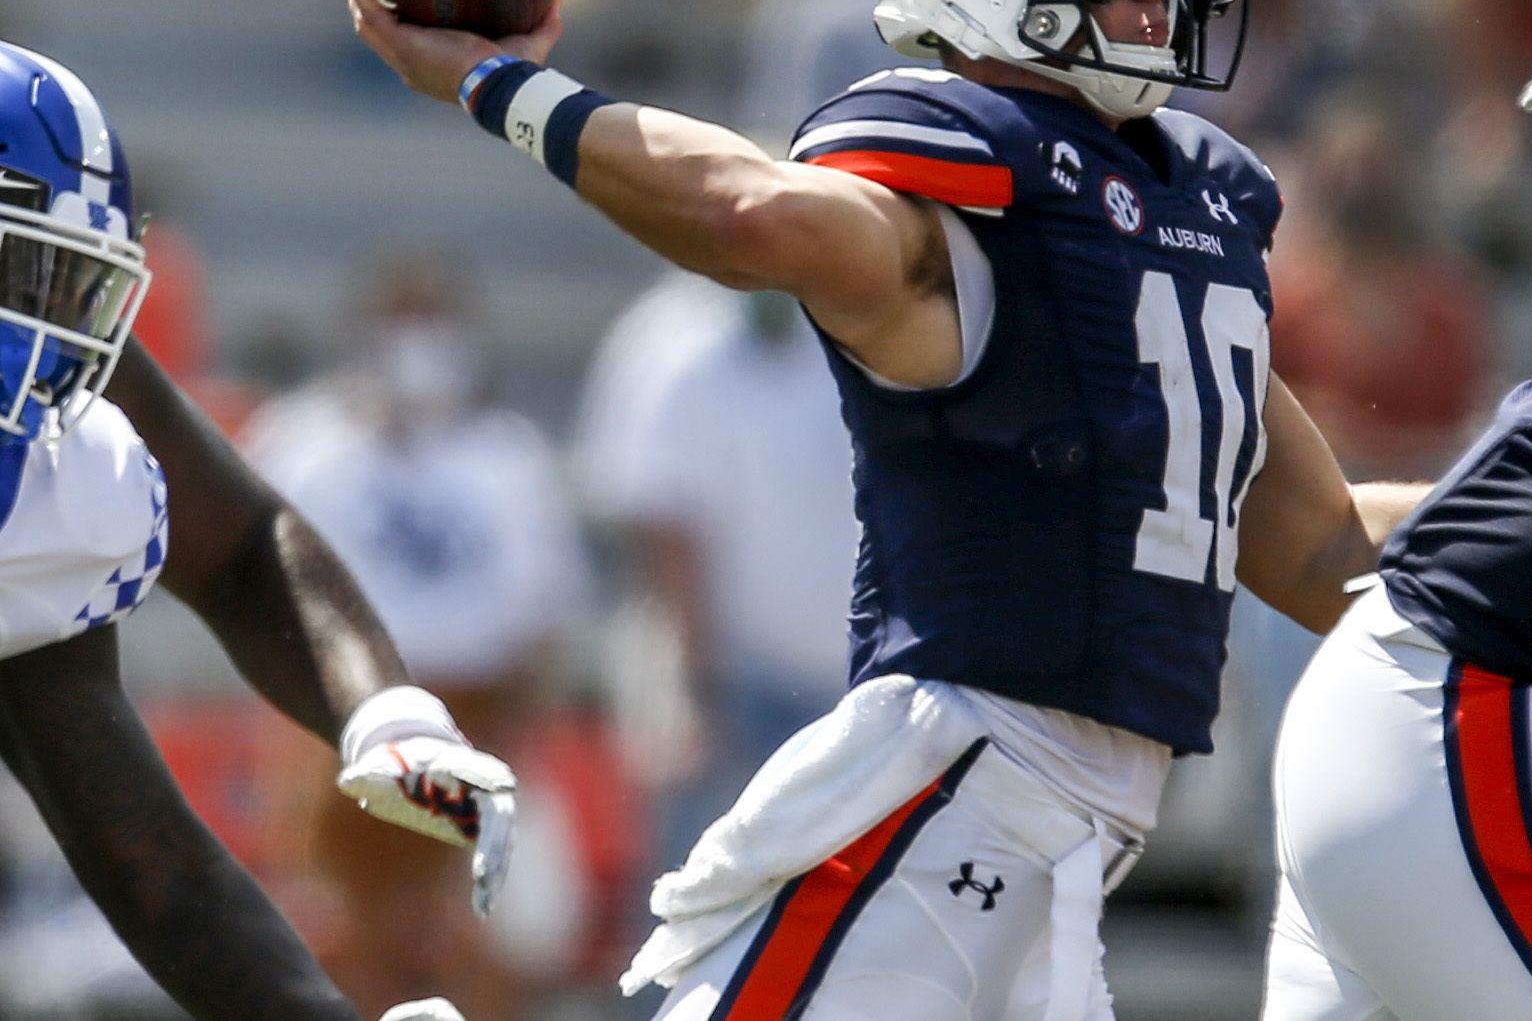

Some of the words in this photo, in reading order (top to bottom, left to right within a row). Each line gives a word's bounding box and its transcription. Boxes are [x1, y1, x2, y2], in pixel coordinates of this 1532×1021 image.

[1105, 180, 1141, 232] SEC
[1157, 226, 1225, 258] AUBURN
[1133, 271, 1270, 592] 10
